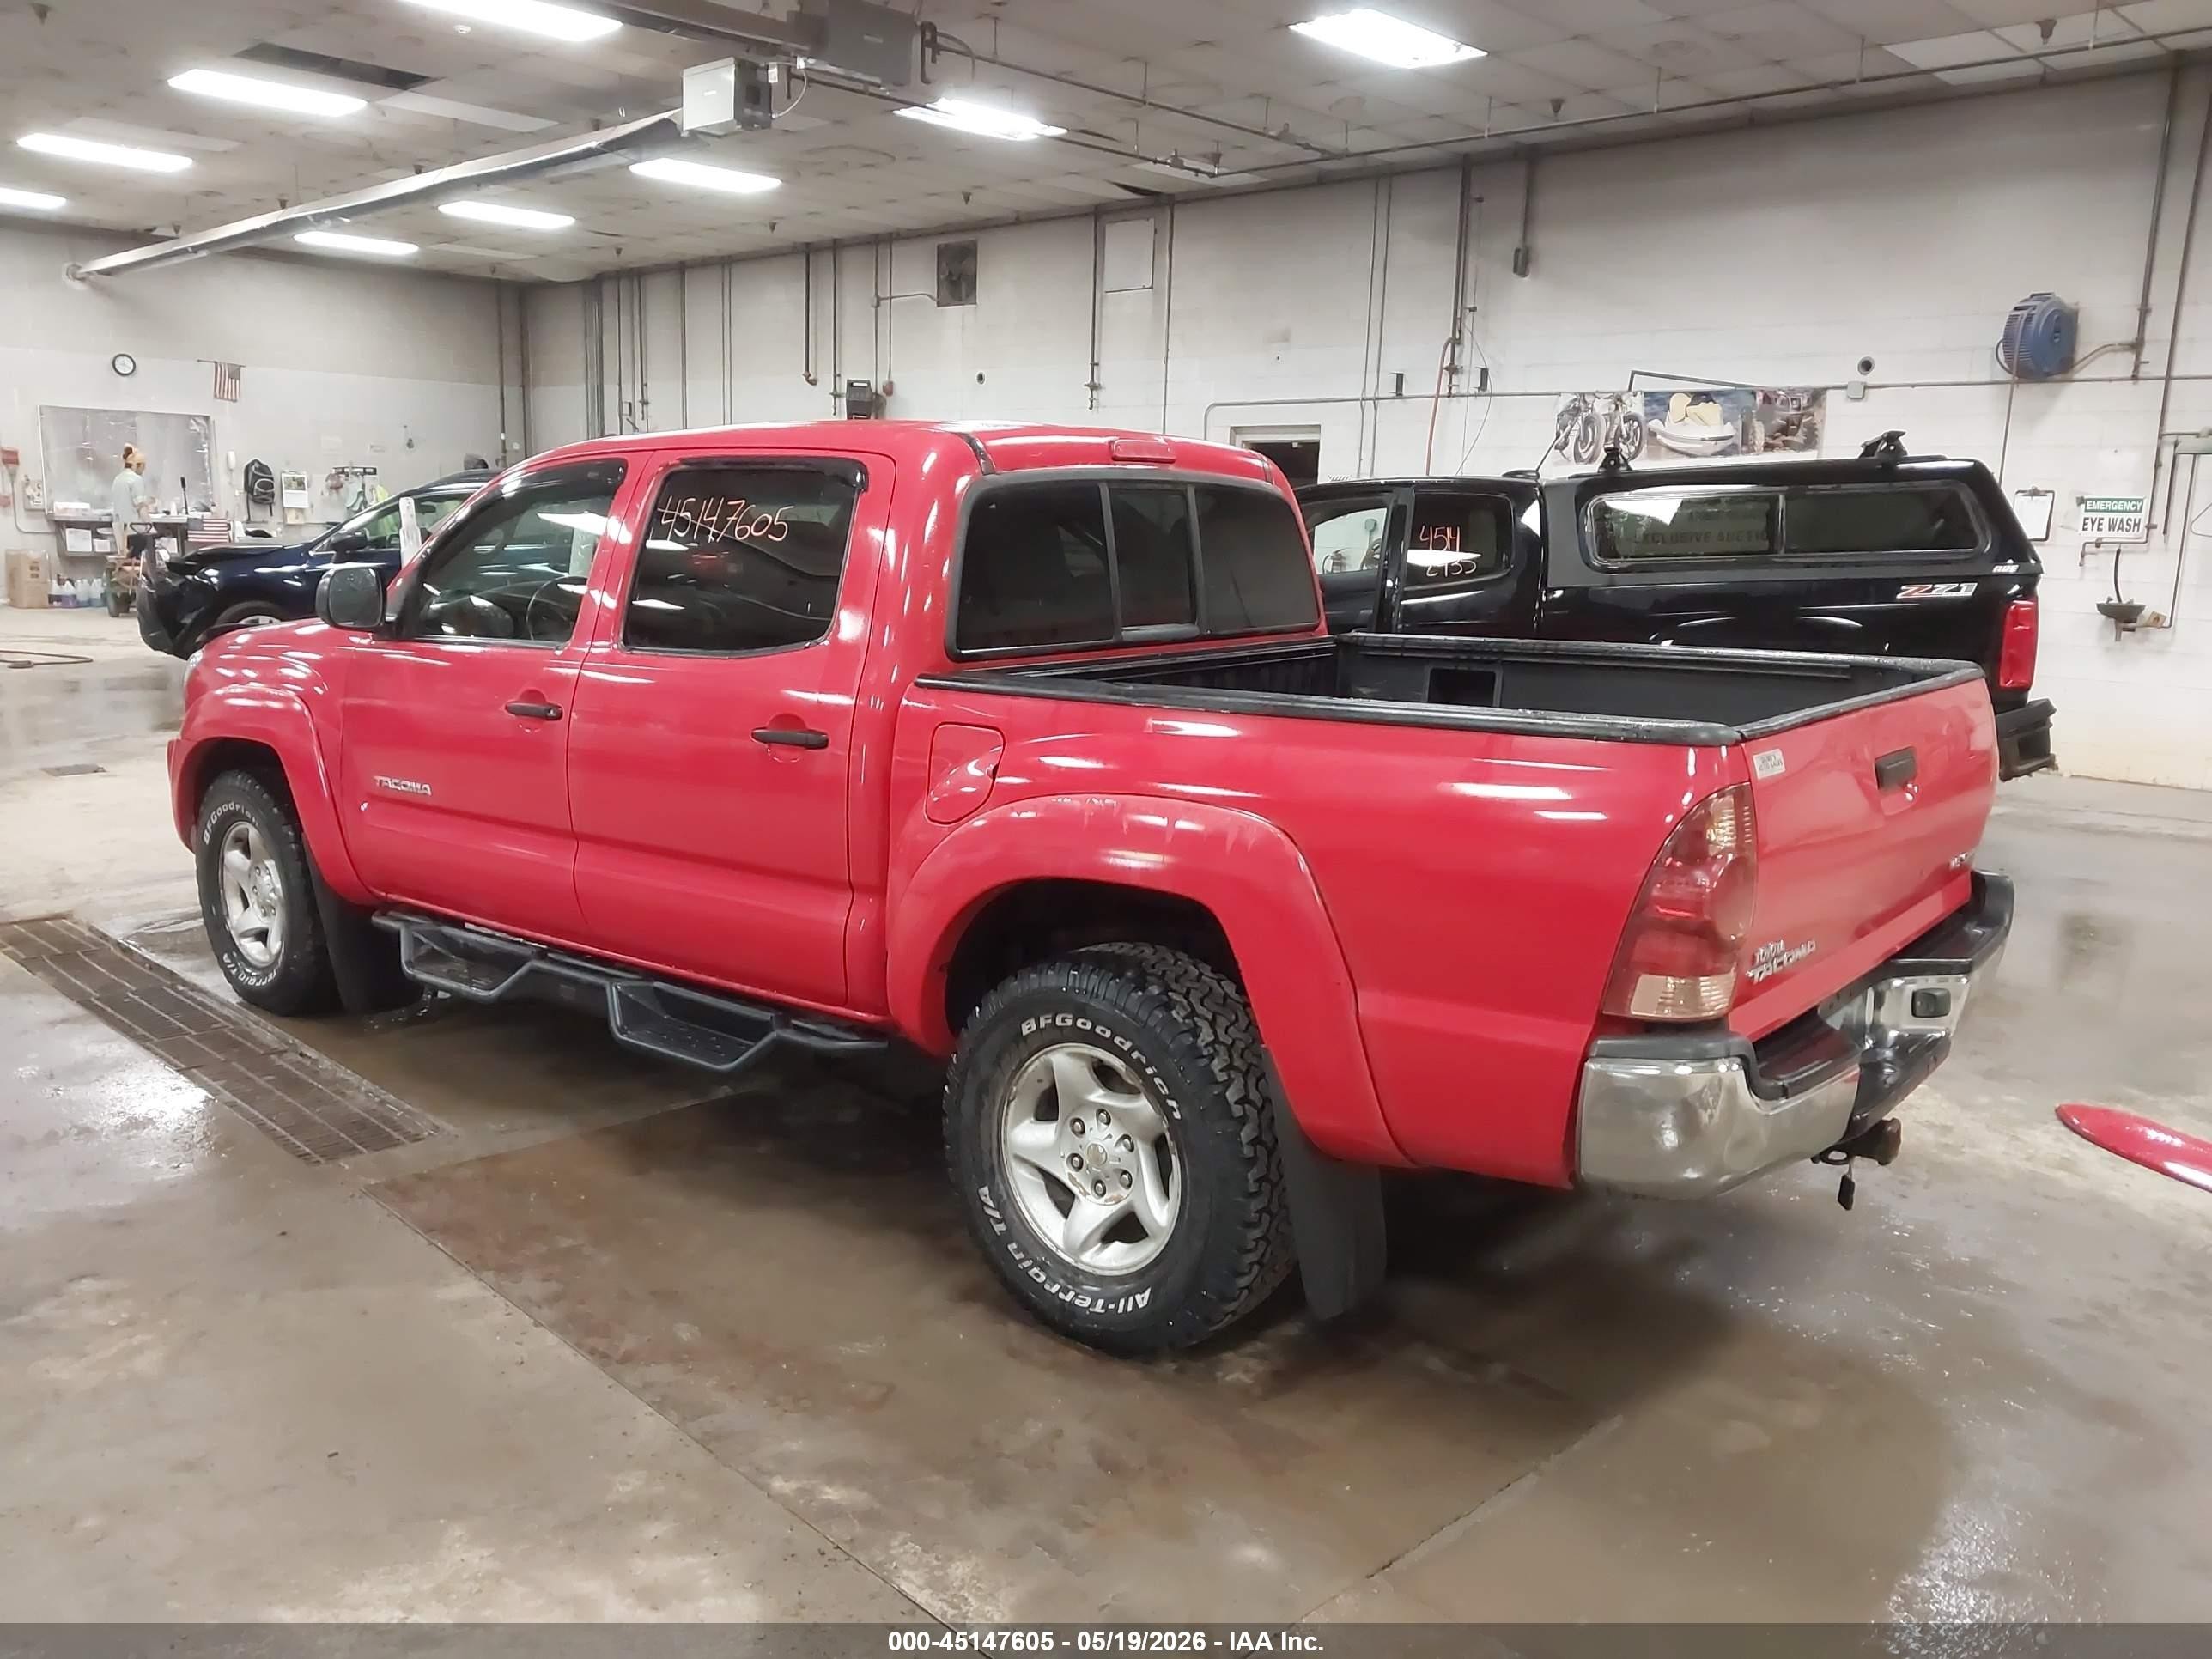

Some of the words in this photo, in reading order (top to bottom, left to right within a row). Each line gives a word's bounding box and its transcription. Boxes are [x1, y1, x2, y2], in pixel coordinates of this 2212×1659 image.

[660, 495, 795, 544] 45147605
[2086, 501, 2142, 511] EMERGENCY
[2082, 517, 2105, 531] EYE
[2108, 517, 2142, 532] WASH
[1419, 525, 1461, 552] 4514
[1896, 582, 1978, 599] Z71
[373, 775, 432, 796] TACOMA
[1021, 1013, 1182, 1121] BFGoodrich
[977, 1185, 1007, 1237] T/A
[1006, 1242, 1152, 1315] All-Terrain
